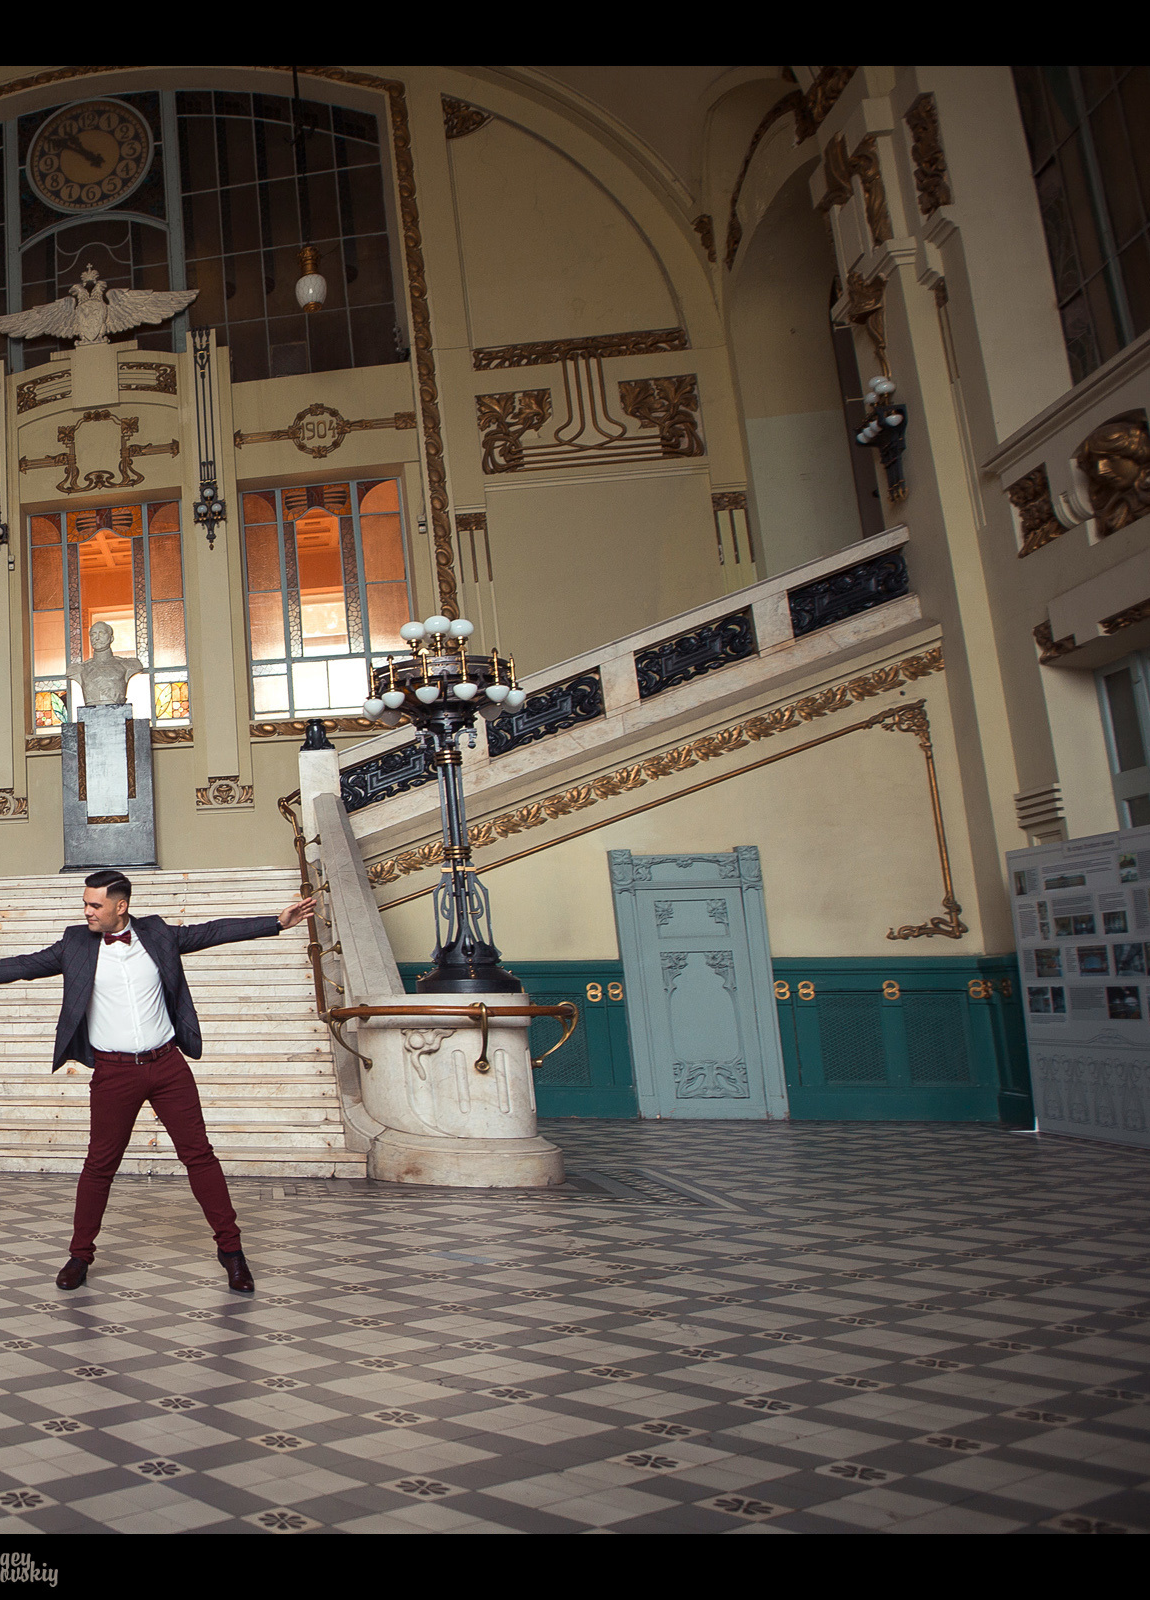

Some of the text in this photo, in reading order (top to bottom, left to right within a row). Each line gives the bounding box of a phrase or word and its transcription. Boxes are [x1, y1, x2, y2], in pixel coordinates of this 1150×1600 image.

[81, 113, 96, 129] 12
[120, 124, 130, 140] 2
[125, 142, 137, 157] 3
[44, 157, 54, 171] 9
[121, 161, 132, 176] 4
[50, 174, 59, 189] 8
[107, 177, 117, 192] 5
[65, 184, 74, 199] 7
[86, 185, 96, 201] 6
[300, 419, 336, 441] 1904
